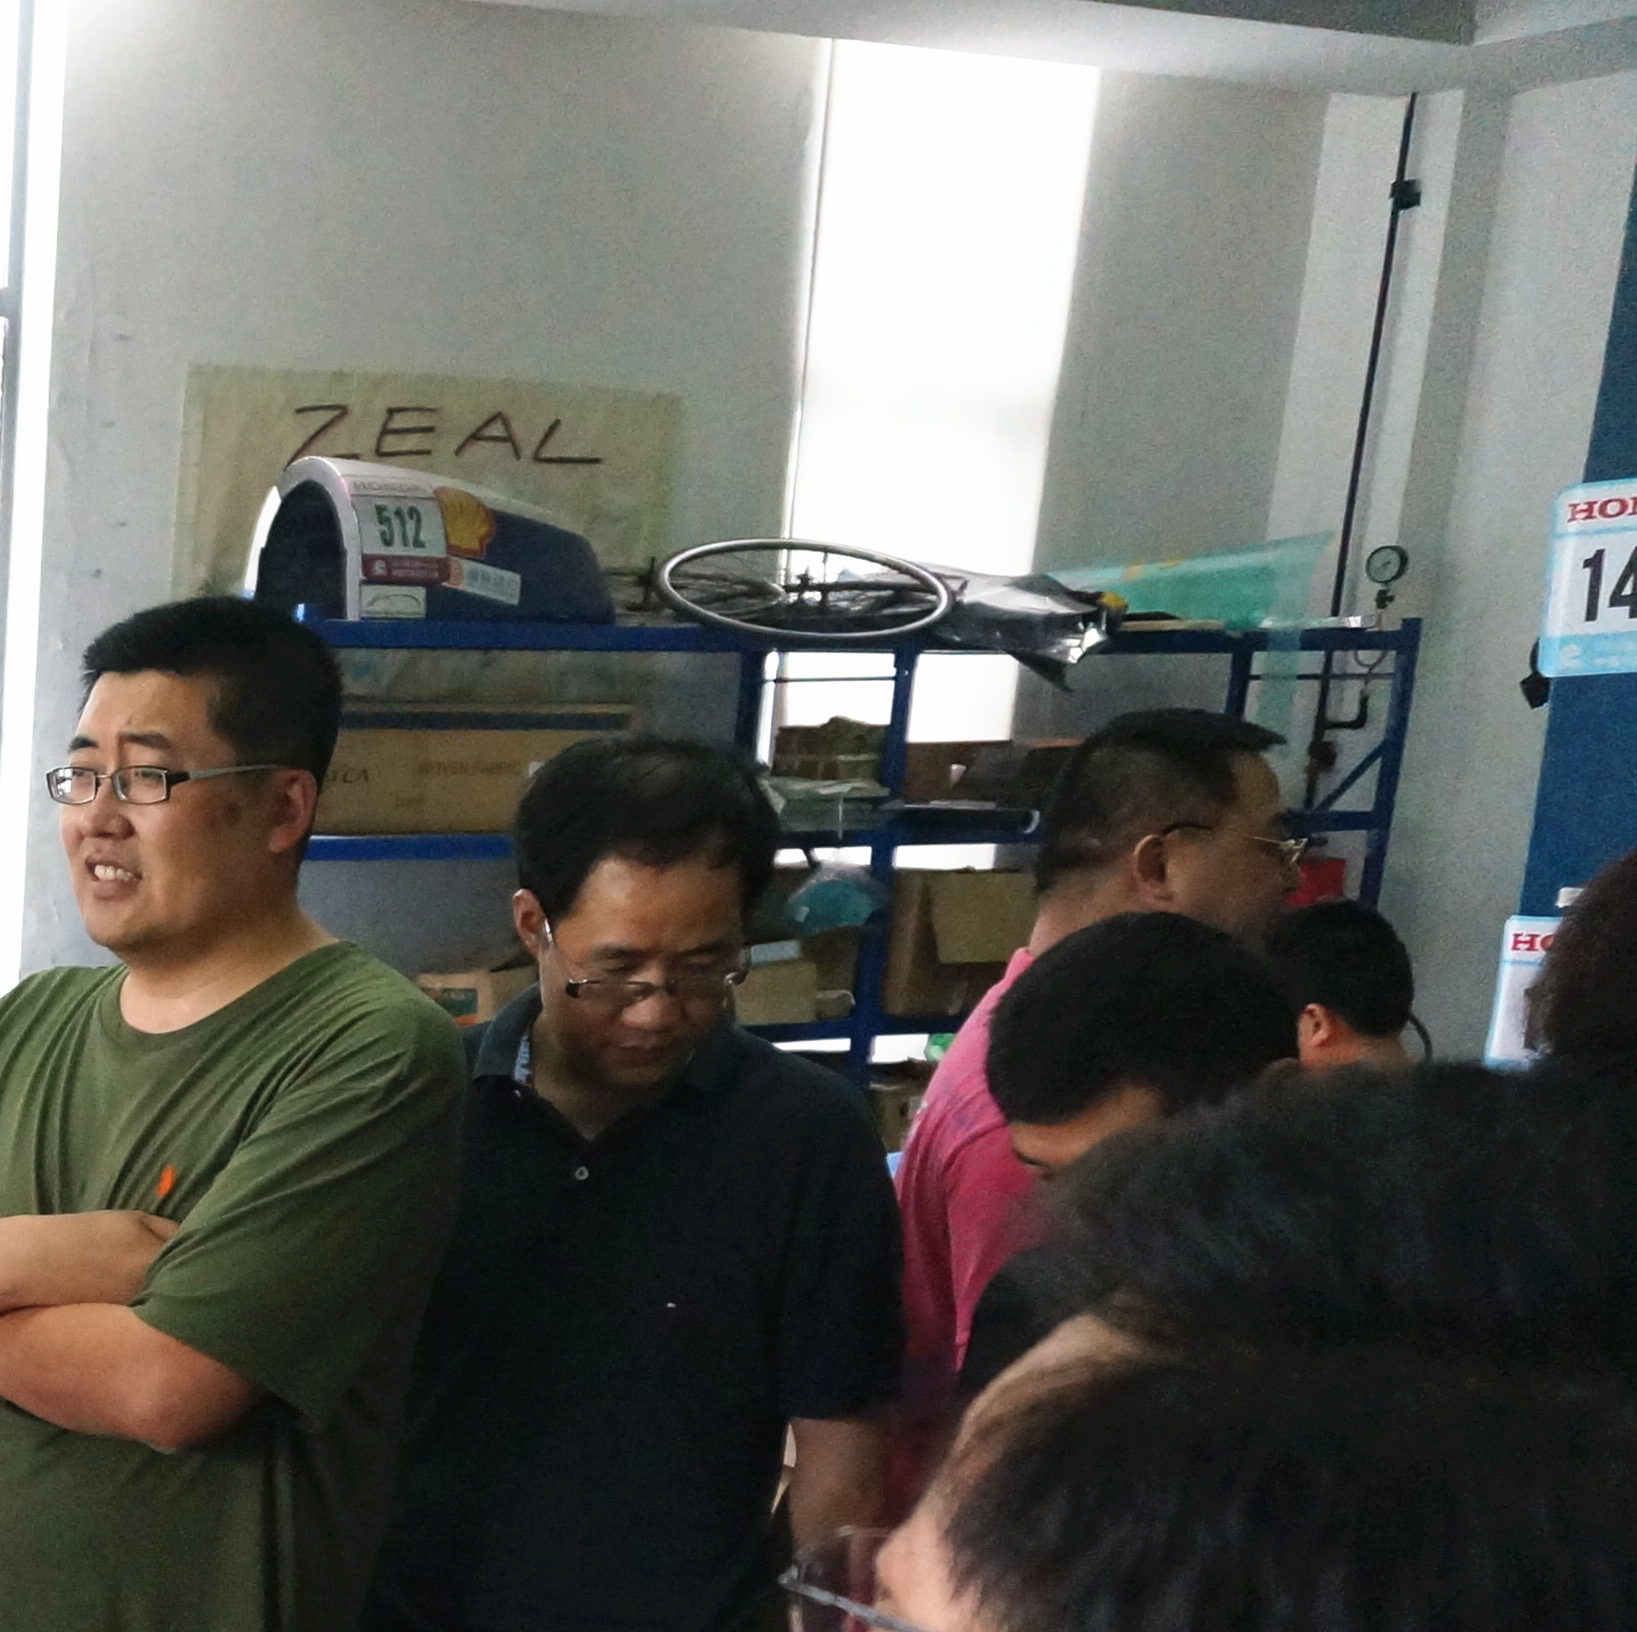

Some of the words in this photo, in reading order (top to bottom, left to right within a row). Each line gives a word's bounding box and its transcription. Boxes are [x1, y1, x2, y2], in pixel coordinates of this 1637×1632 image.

[285, 403, 603, 470] ZEAL
[375, 504, 426, 549] 512
[1582, 545, 1637, 622] 14
